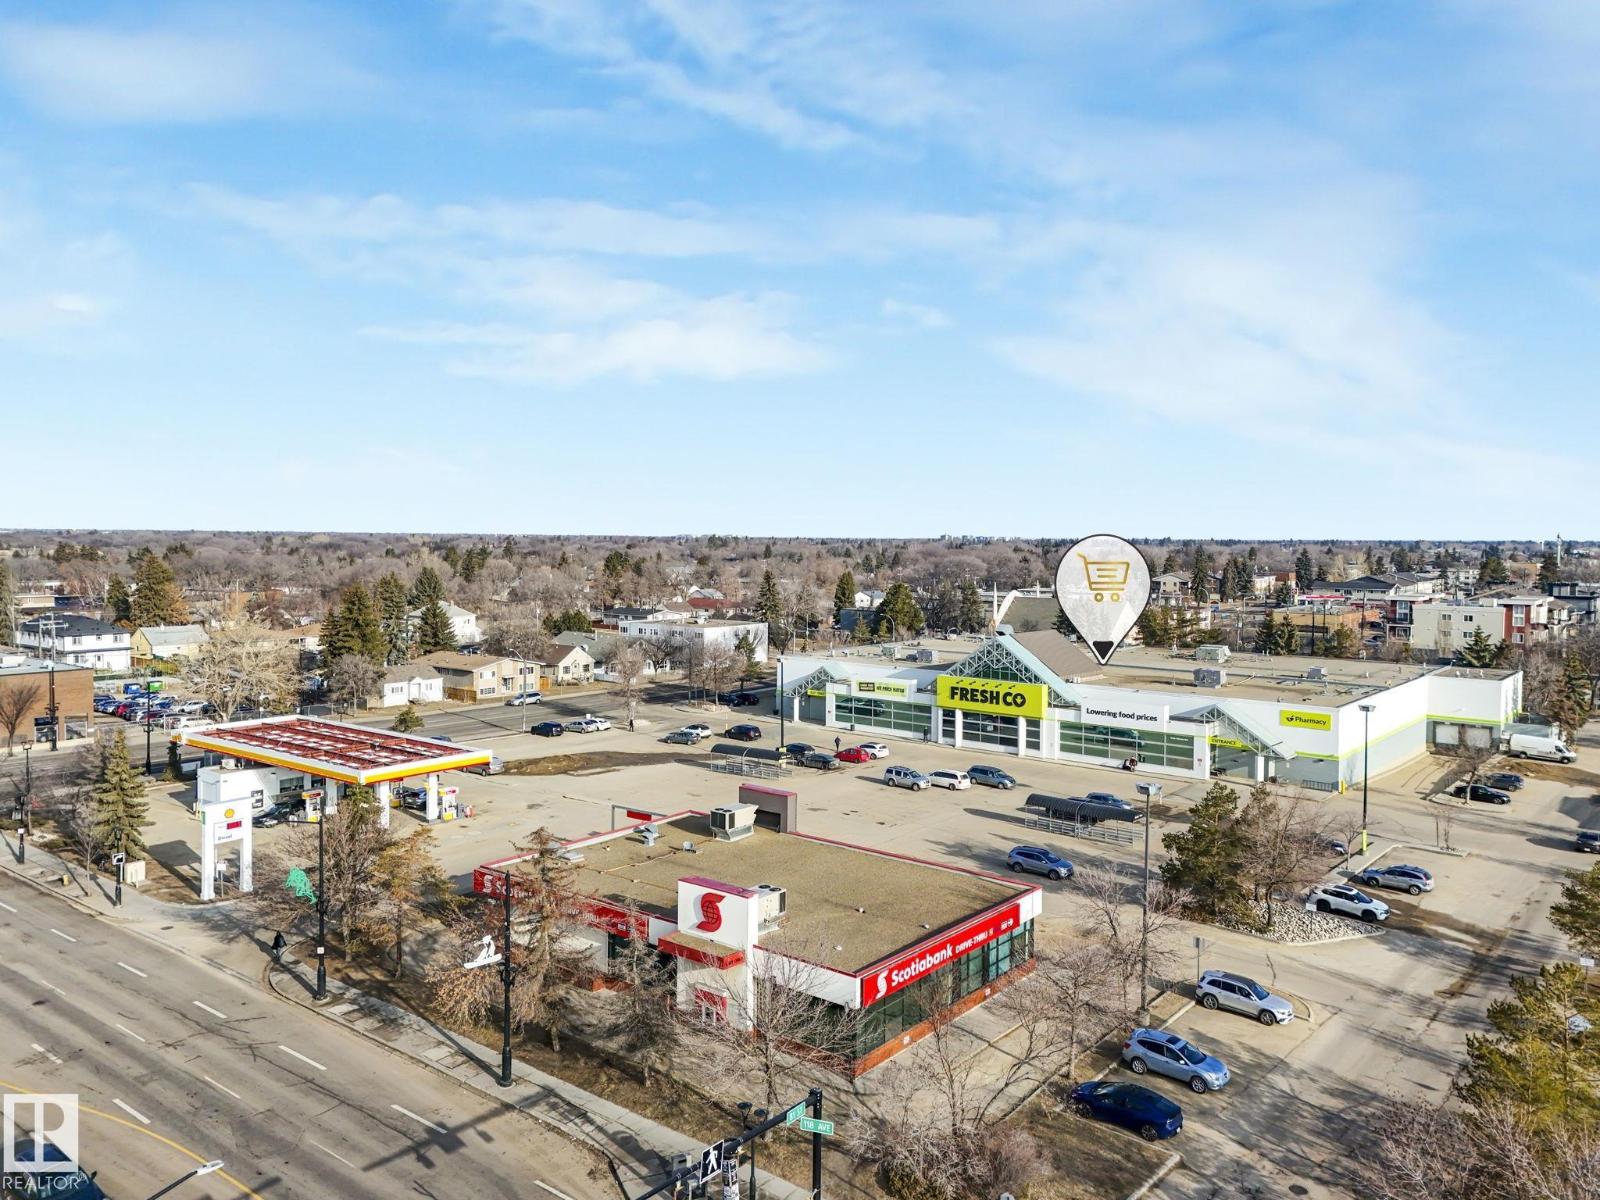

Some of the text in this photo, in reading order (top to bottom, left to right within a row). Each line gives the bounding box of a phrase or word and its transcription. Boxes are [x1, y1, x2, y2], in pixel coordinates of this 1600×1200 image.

[1086, 707, 1158, 723] Lowering food prices
[1295, 716, 1327, 727] Pharmacy
[891, 930, 988, 986] Scotiabank DRIVE-THRU
[817, 1123, 831, 1132] AVE
